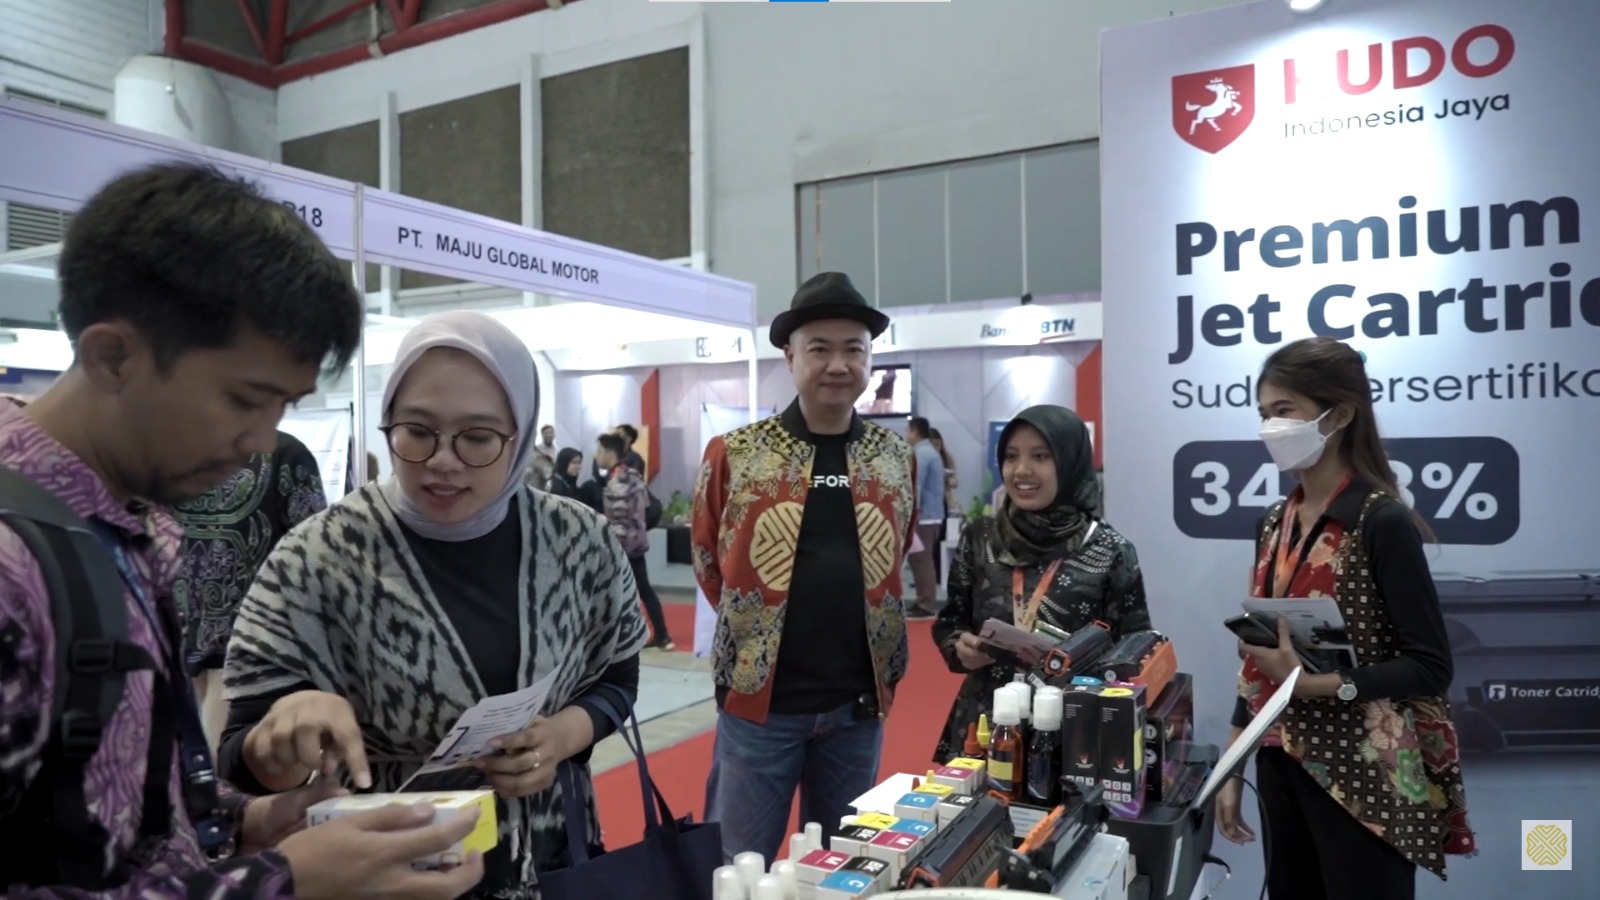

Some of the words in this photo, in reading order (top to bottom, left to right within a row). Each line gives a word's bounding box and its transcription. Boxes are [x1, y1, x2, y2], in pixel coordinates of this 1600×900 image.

[1284, 104, 1424, 139] Indonesia
[1434, 94, 1510, 121] Jaya
[397, 226, 423, 248] PT.
[436, 233, 482, 260] MAJU
[487, 246, 548, 274] GLOBAL
[552, 260, 600, 285] MOTOR
[1175, 195, 1581, 276] Premium
[980, 323, 1009, 339] Ban
[1040, 318, 1075, 334] BTN
[1168, 294, 1282, 365] Jet
[1172, 375, 1252, 409] Sud
[1510, 686, 1551, 698] Toner
[1555, 685, 1600, 699] Catrid
